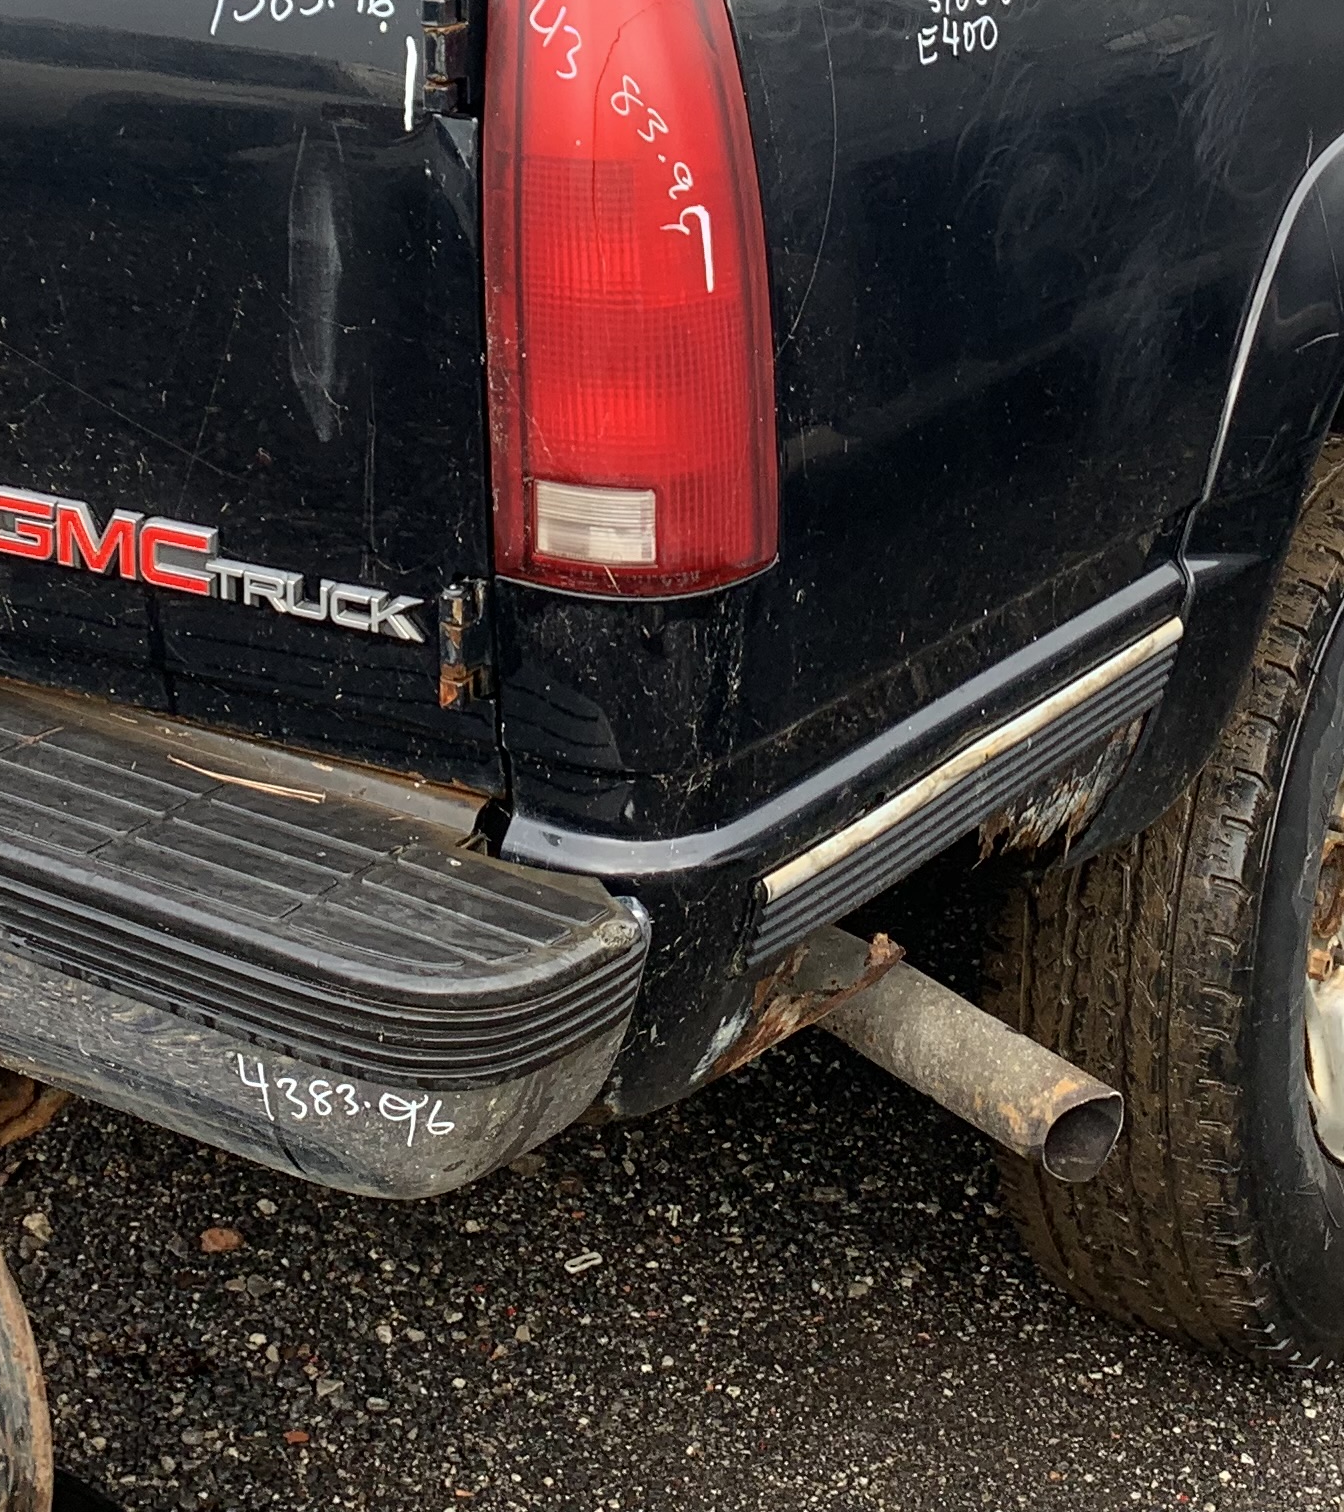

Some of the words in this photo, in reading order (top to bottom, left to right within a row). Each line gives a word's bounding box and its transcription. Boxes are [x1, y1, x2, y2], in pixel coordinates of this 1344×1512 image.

[917, 15, 998, 65] E400
[205, 558, 427, 644] TRUCK
[236, 1052, 455, 1148] 4383.96
